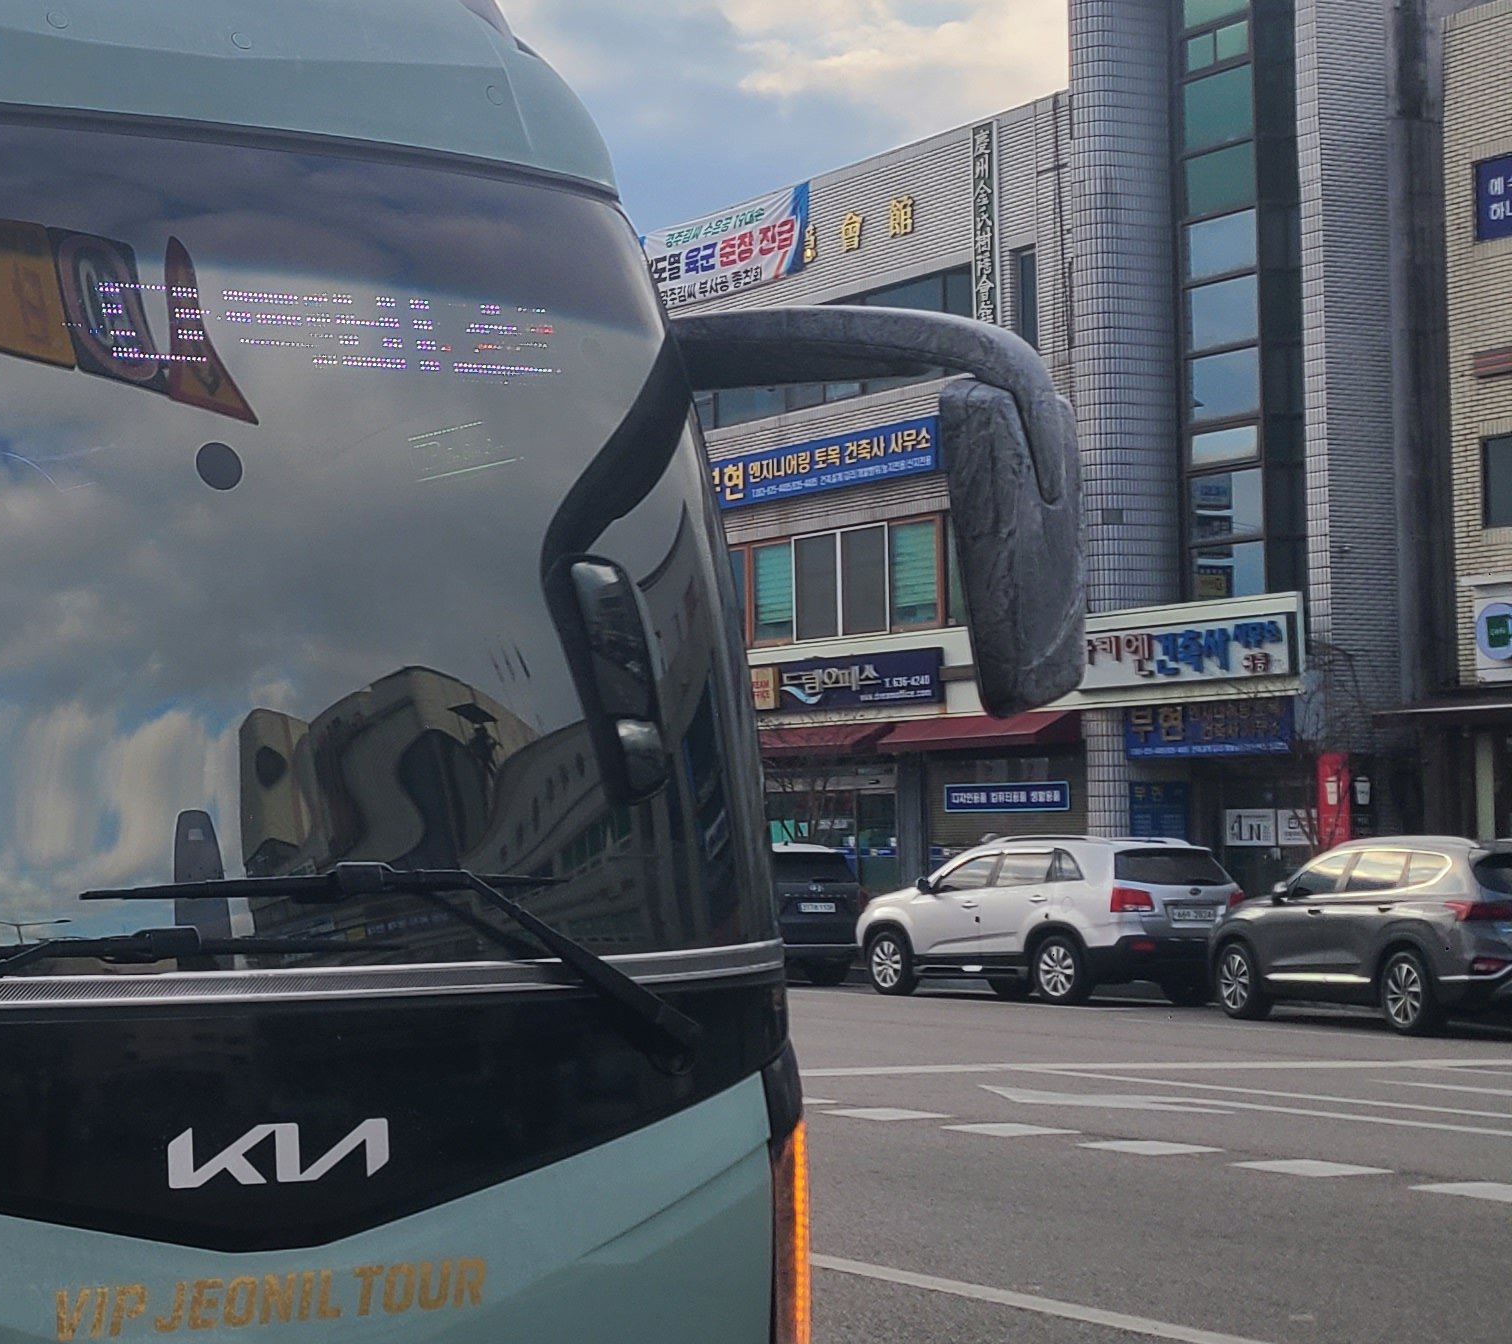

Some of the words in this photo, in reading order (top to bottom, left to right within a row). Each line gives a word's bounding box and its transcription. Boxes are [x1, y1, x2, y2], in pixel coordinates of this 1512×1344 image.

[650, 251, 682, 284] 도열
[685, 241, 718, 275] 육군
[719, 229, 755, 268] 준장
[758, 215, 796, 256] 진급
[748, 451, 811, 484] 엔지니어링
[814, 444, 841, 469] 토목
[844, 435, 886, 466] 건축사
[888, 426, 932, 455] 사무소
[782, 663, 882, 695] 드림오피스
[167, 1117, 390, 1189] KIA
[55, 1283, 149, 1343] VIP
[154, 1267, 343, 1334] JEONIL
[353, 1257, 487, 1317] TOUR
